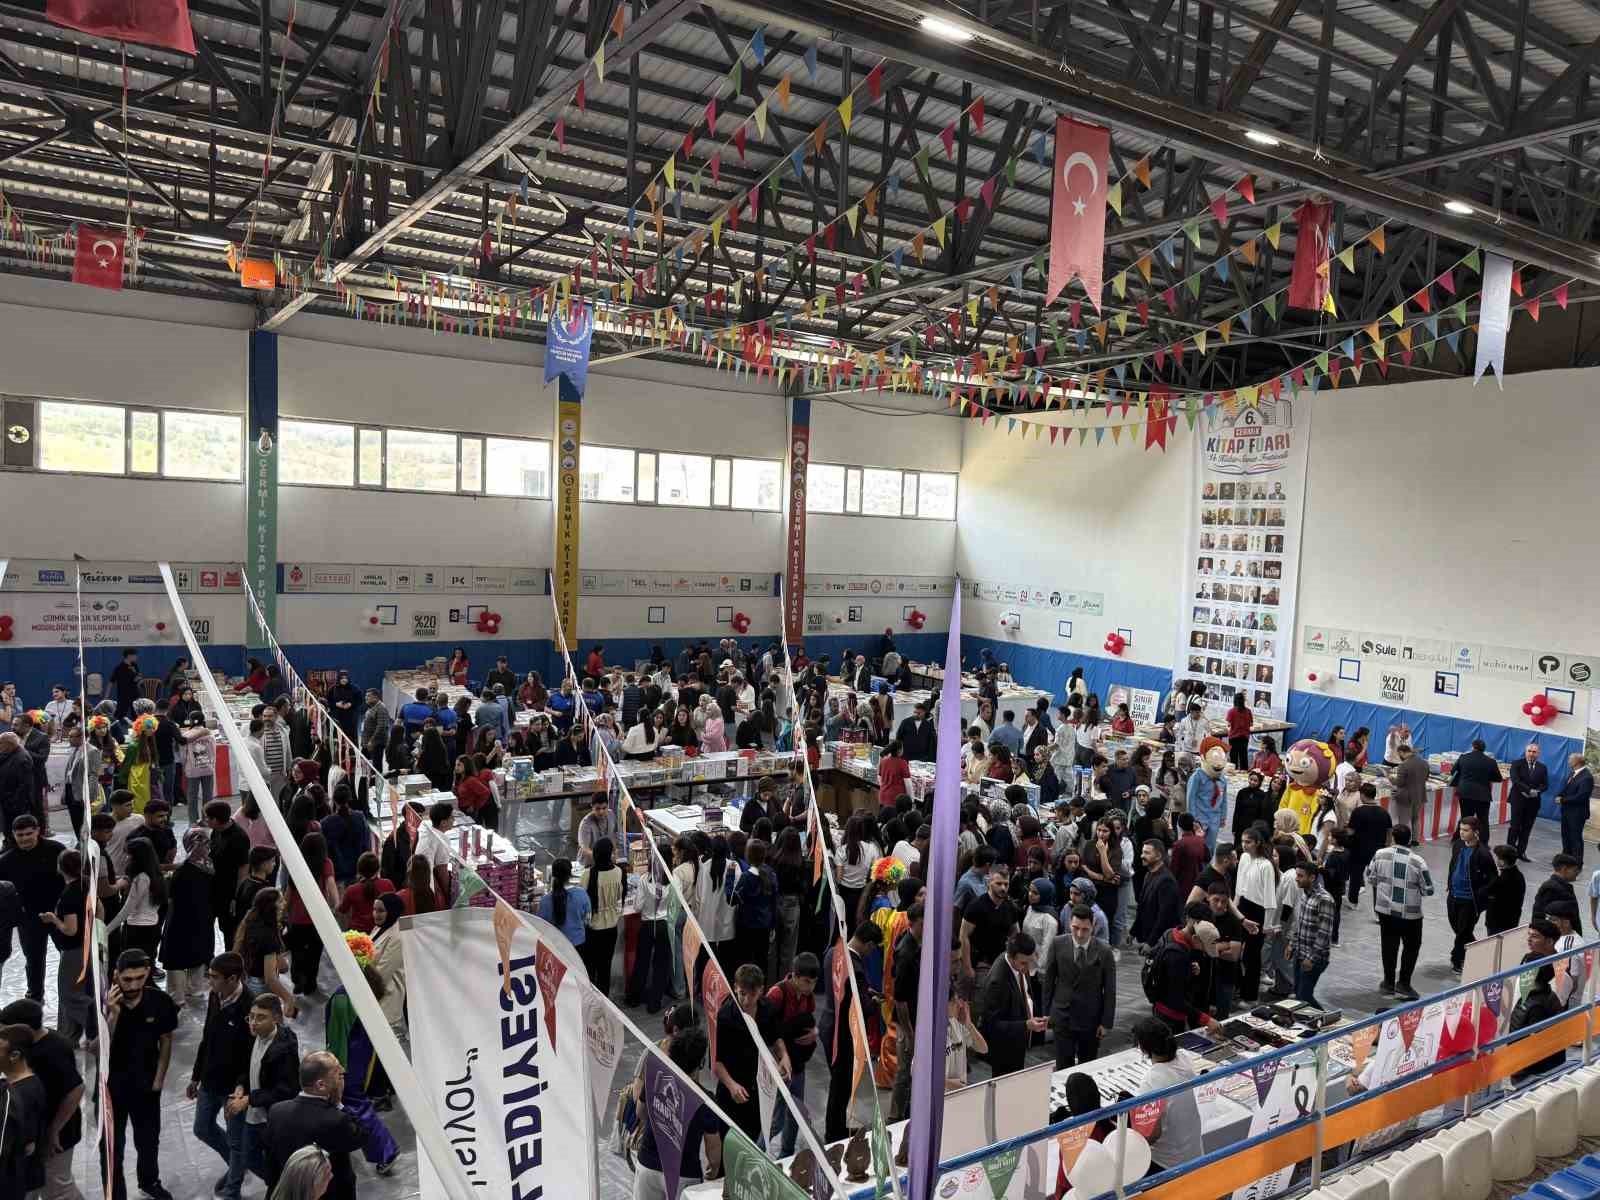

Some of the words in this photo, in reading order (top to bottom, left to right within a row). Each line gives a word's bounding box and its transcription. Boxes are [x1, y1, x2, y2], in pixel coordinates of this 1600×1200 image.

[1245, 411, 1256, 425] 6.
[1207, 436, 1244, 454] KİTAP
[1249, 433, 1290, 453] FUARI
[414, 615, 437, 629] %20
[1375, 643, 1397, 657] Şule
[1382, 675, 1406, 693] %20
